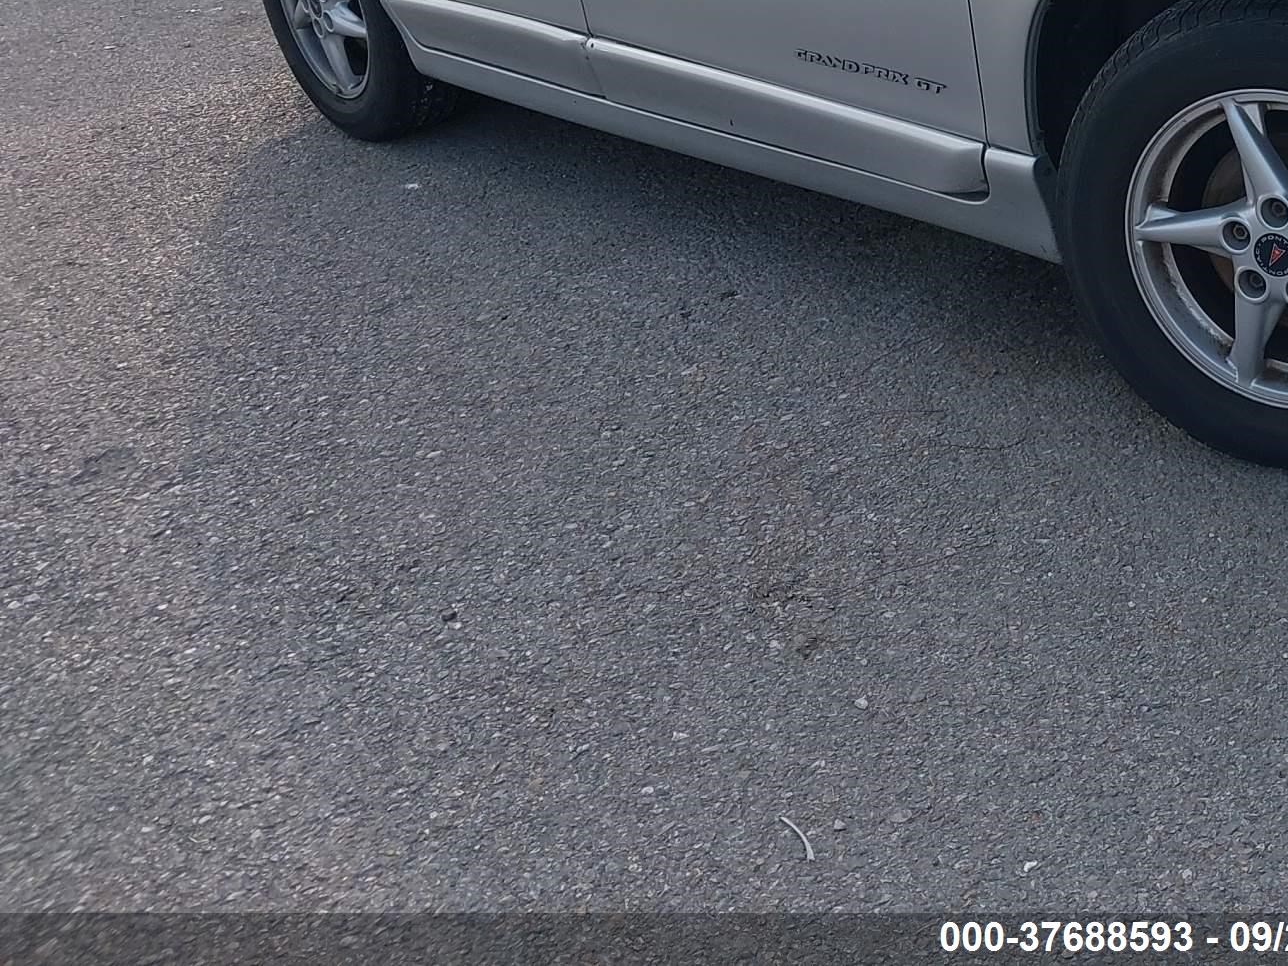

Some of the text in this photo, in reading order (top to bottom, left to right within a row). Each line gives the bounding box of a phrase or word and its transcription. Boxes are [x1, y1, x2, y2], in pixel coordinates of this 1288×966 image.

[794, 48, 948, 94] GRAND PRIX GT
